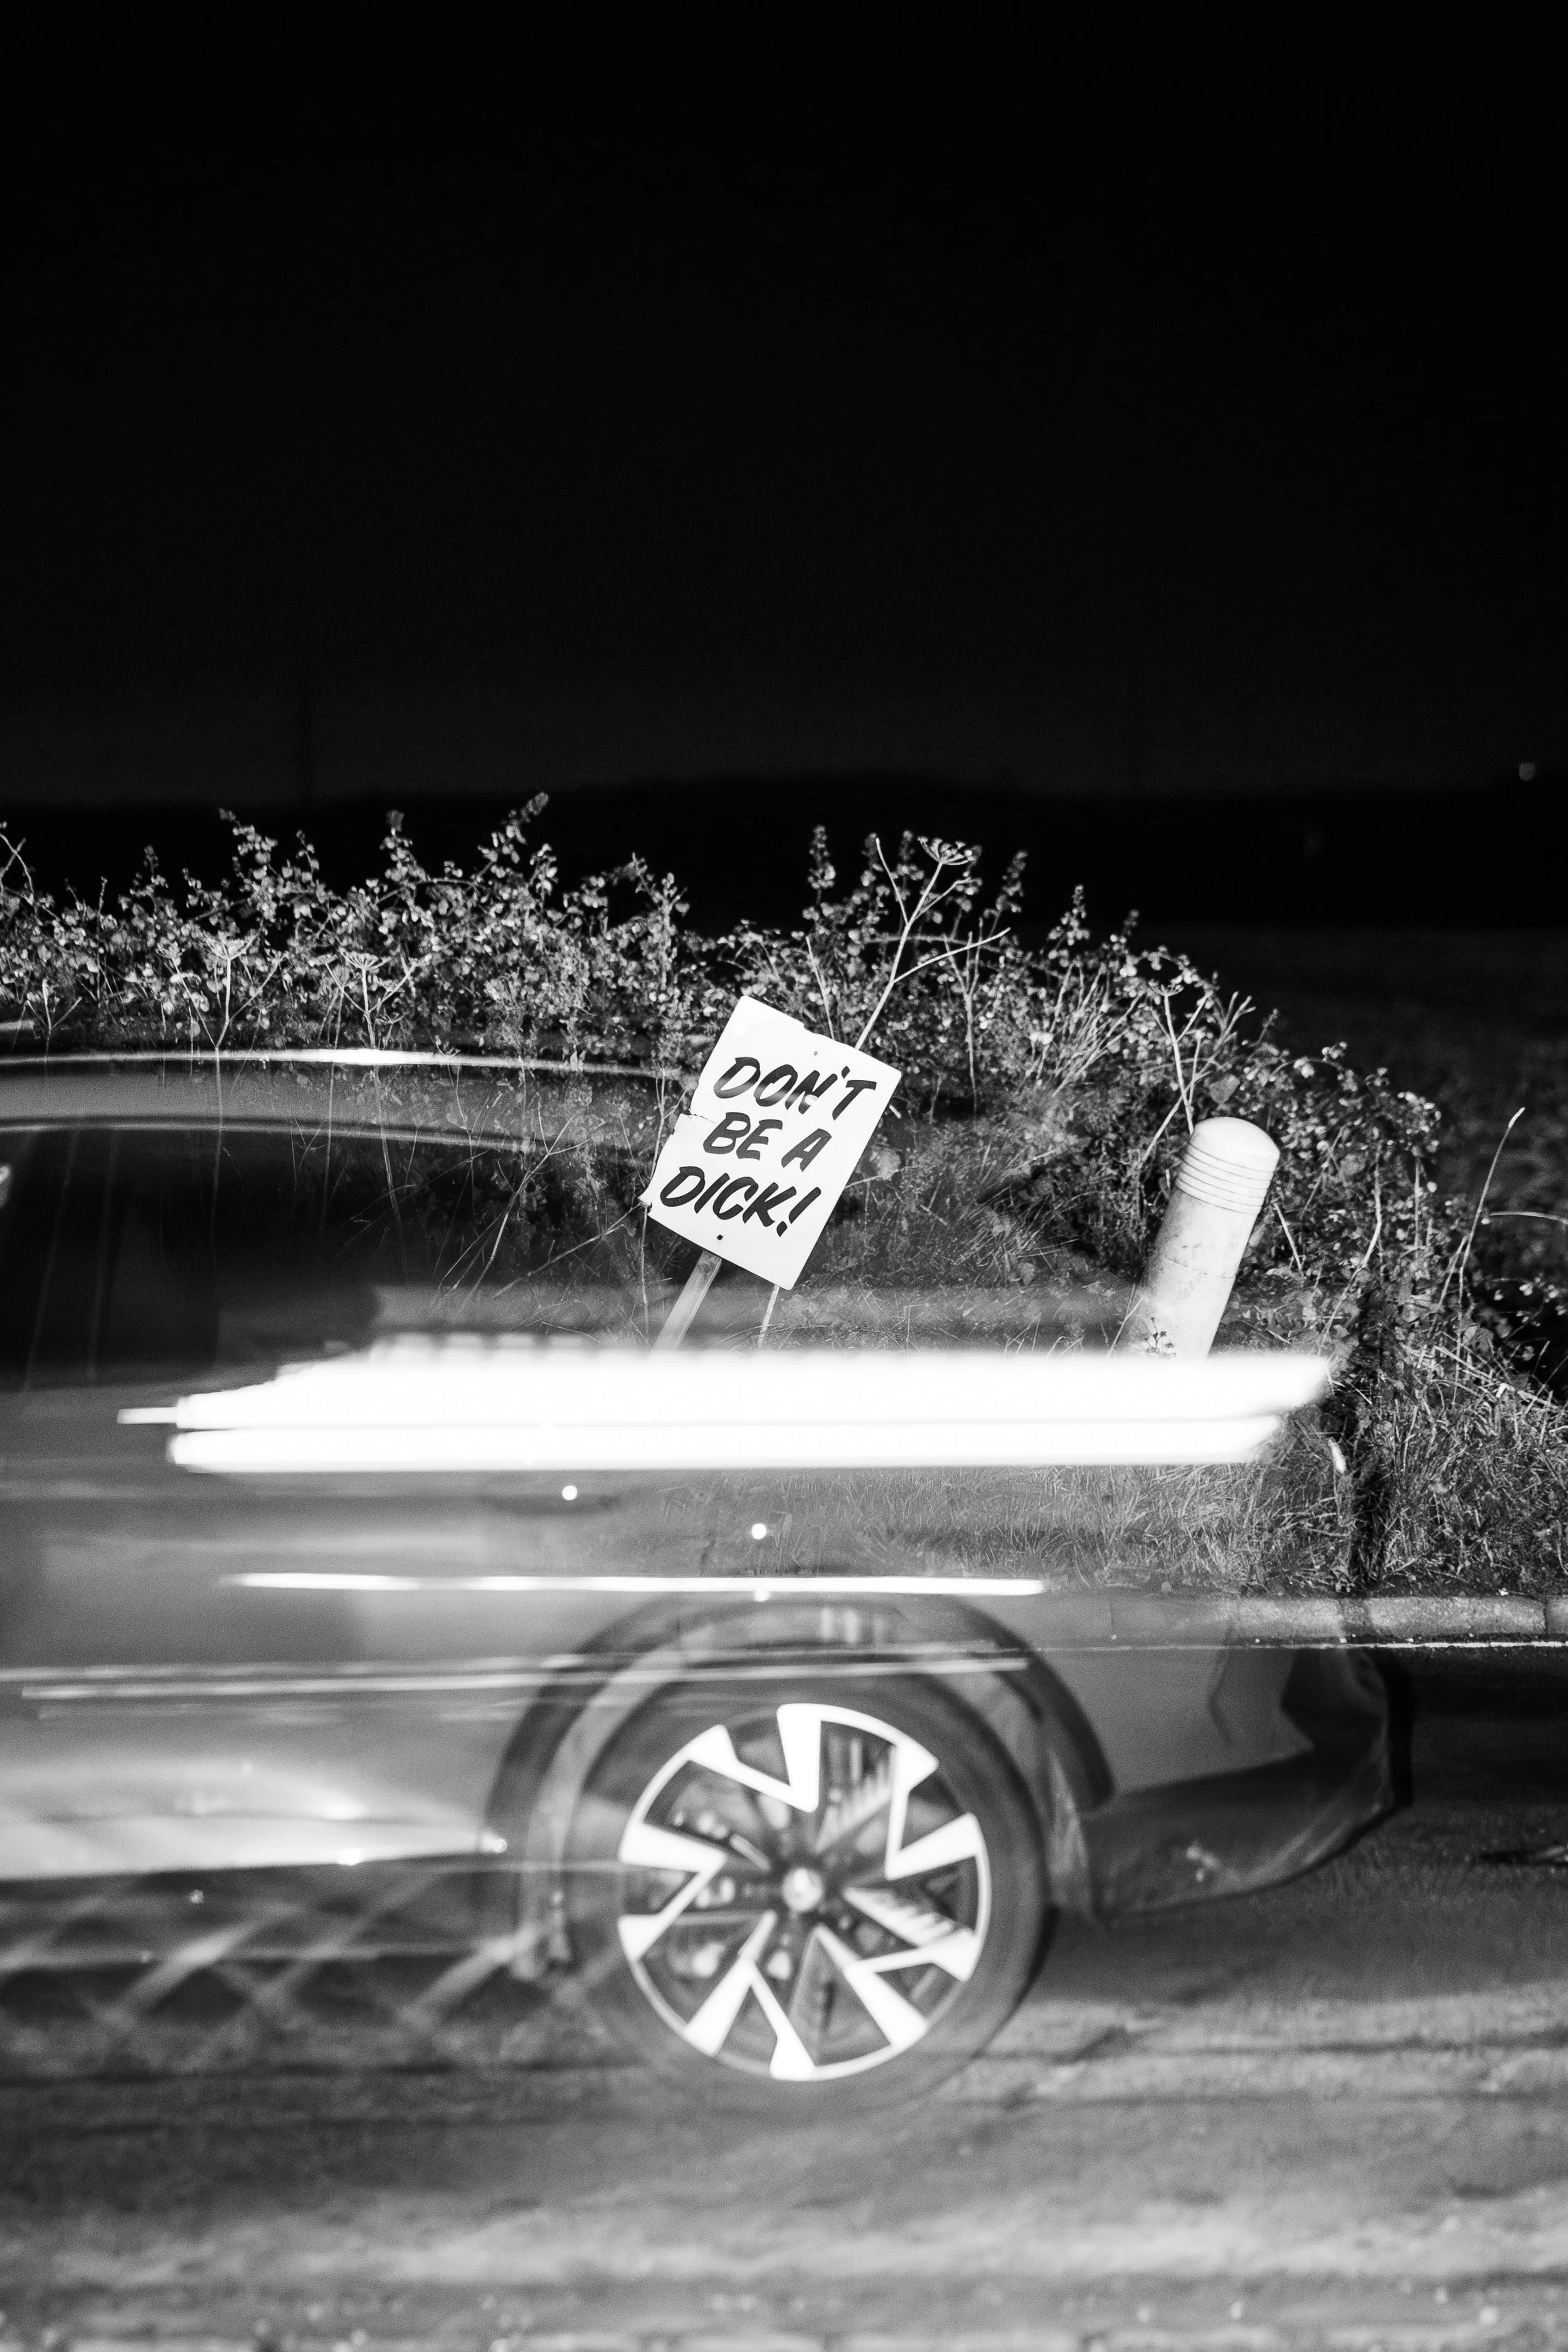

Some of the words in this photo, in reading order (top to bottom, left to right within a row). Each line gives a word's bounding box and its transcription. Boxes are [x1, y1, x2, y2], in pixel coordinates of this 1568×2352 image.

[713, 1057, 877, 1120] DON'T
[703, 1112, 783, 1161] BE
[781, 1128, 832, 1172] A
[660, 1166, 822, 1237] DICK!
